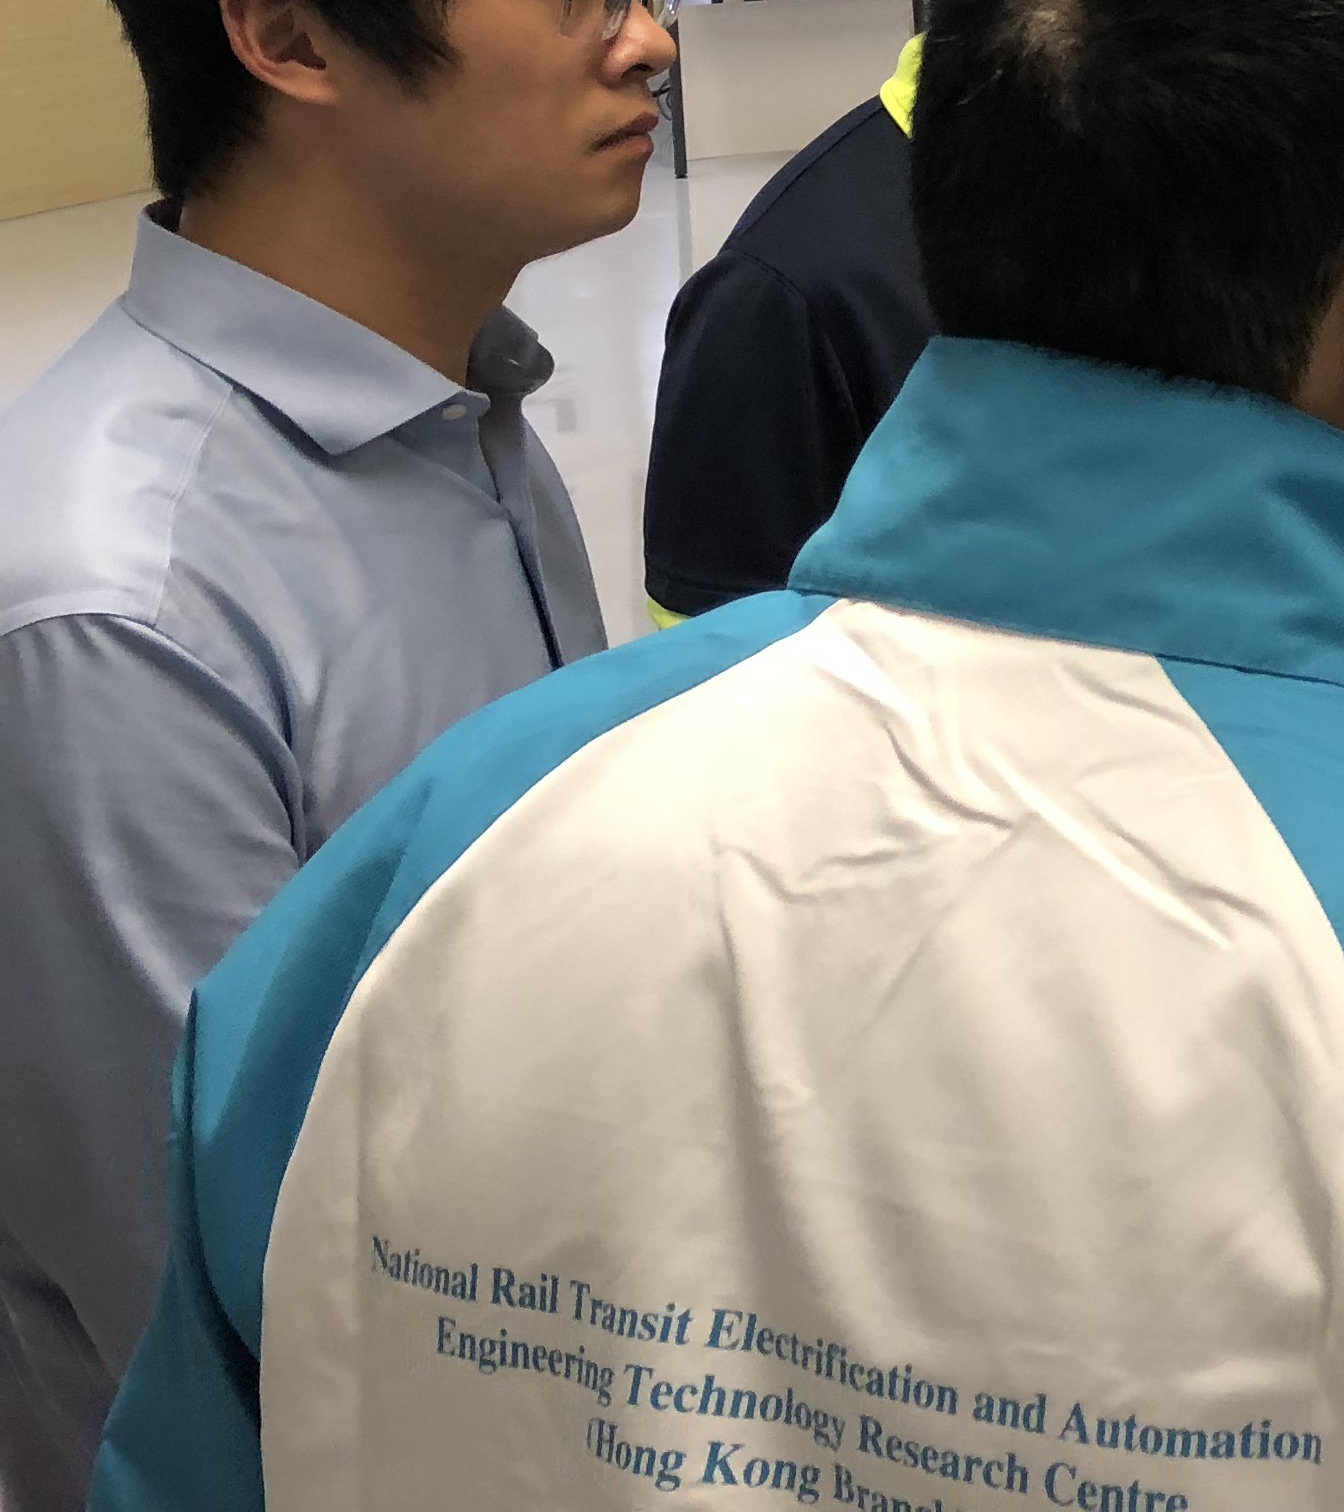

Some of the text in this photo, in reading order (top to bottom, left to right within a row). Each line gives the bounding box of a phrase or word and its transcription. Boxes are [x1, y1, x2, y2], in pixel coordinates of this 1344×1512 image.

[372, 1235, 1323, 1464] National Rail Transit Electrification and Automation
[436, 1315, 614, 1408] Engineering
[623, 1363, 846, 1451] Technology
[858, 1413, 1029, 1494] Research
[586, 1417, 687, 1493] (Hong
[699, 1440, 822, 1504] Kong
